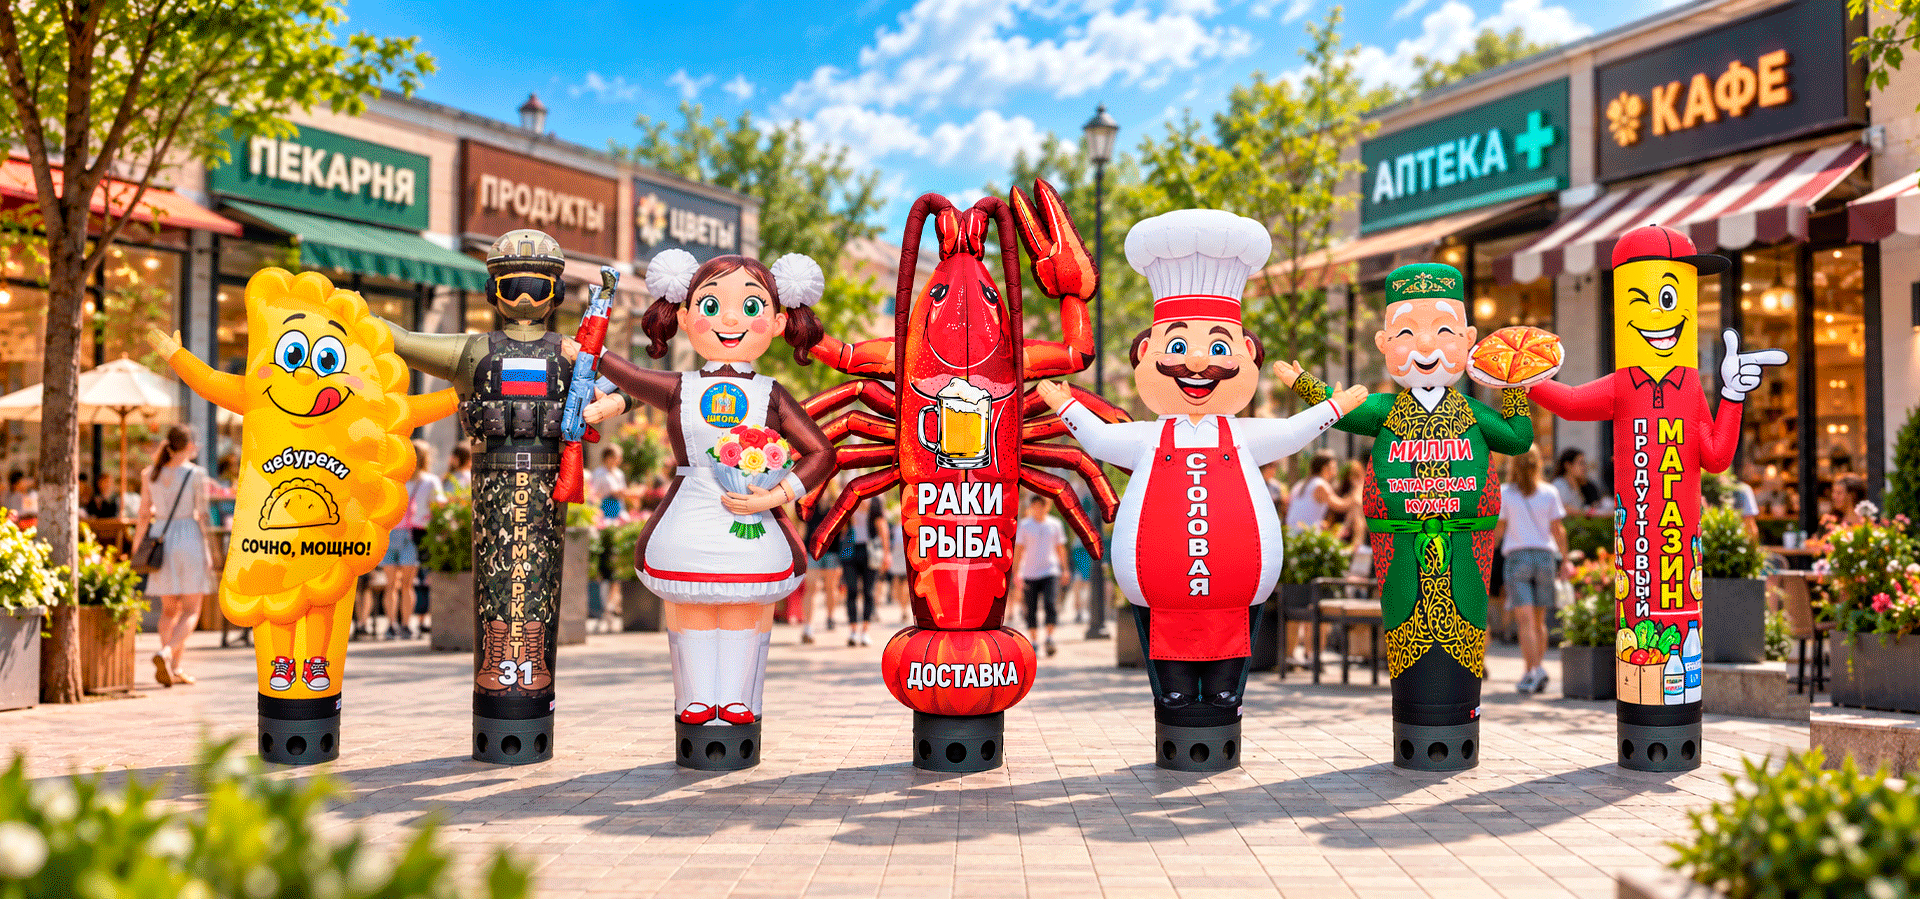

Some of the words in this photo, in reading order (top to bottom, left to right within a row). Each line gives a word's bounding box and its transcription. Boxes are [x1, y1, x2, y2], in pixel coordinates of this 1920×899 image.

[1652, 49, 1790, 137] КАФЕ
[248, 135, 416, 206] ПЕКАРНЯ
[1372, 127, 1508, 204] АПТЕКА
[480, 174, 605, 232] ПРОДУКТЫ
[669, 207, 736, 250] ЦВЕТЫ
[262, 447, 351, 480] чебуреки
[1388, 438, 1473, 463] МИЛЛИ
[917, 481, 1003, 516] РАКИ
[1387, 476, 1477, 493] ТАТАРСКАЯ
[1405, 498, 1460, 513] КУХНЯ
[1657, 417, 1684, 609] МАГАЗИН
[919, 525, 1003, 558] РЫБА
[1186, 452, 1212, 597] СТОЛОВАЯ
[241, 538, 296, 558] СОЧНО,
[300, 540, 371, 557] МОЩНО!
[510, 472, 530, 659] ВОЕНМАРКЕТ
[498, 660, 533, 686] 31
[907, 661, 1018, 690] ДОСТАВКА
